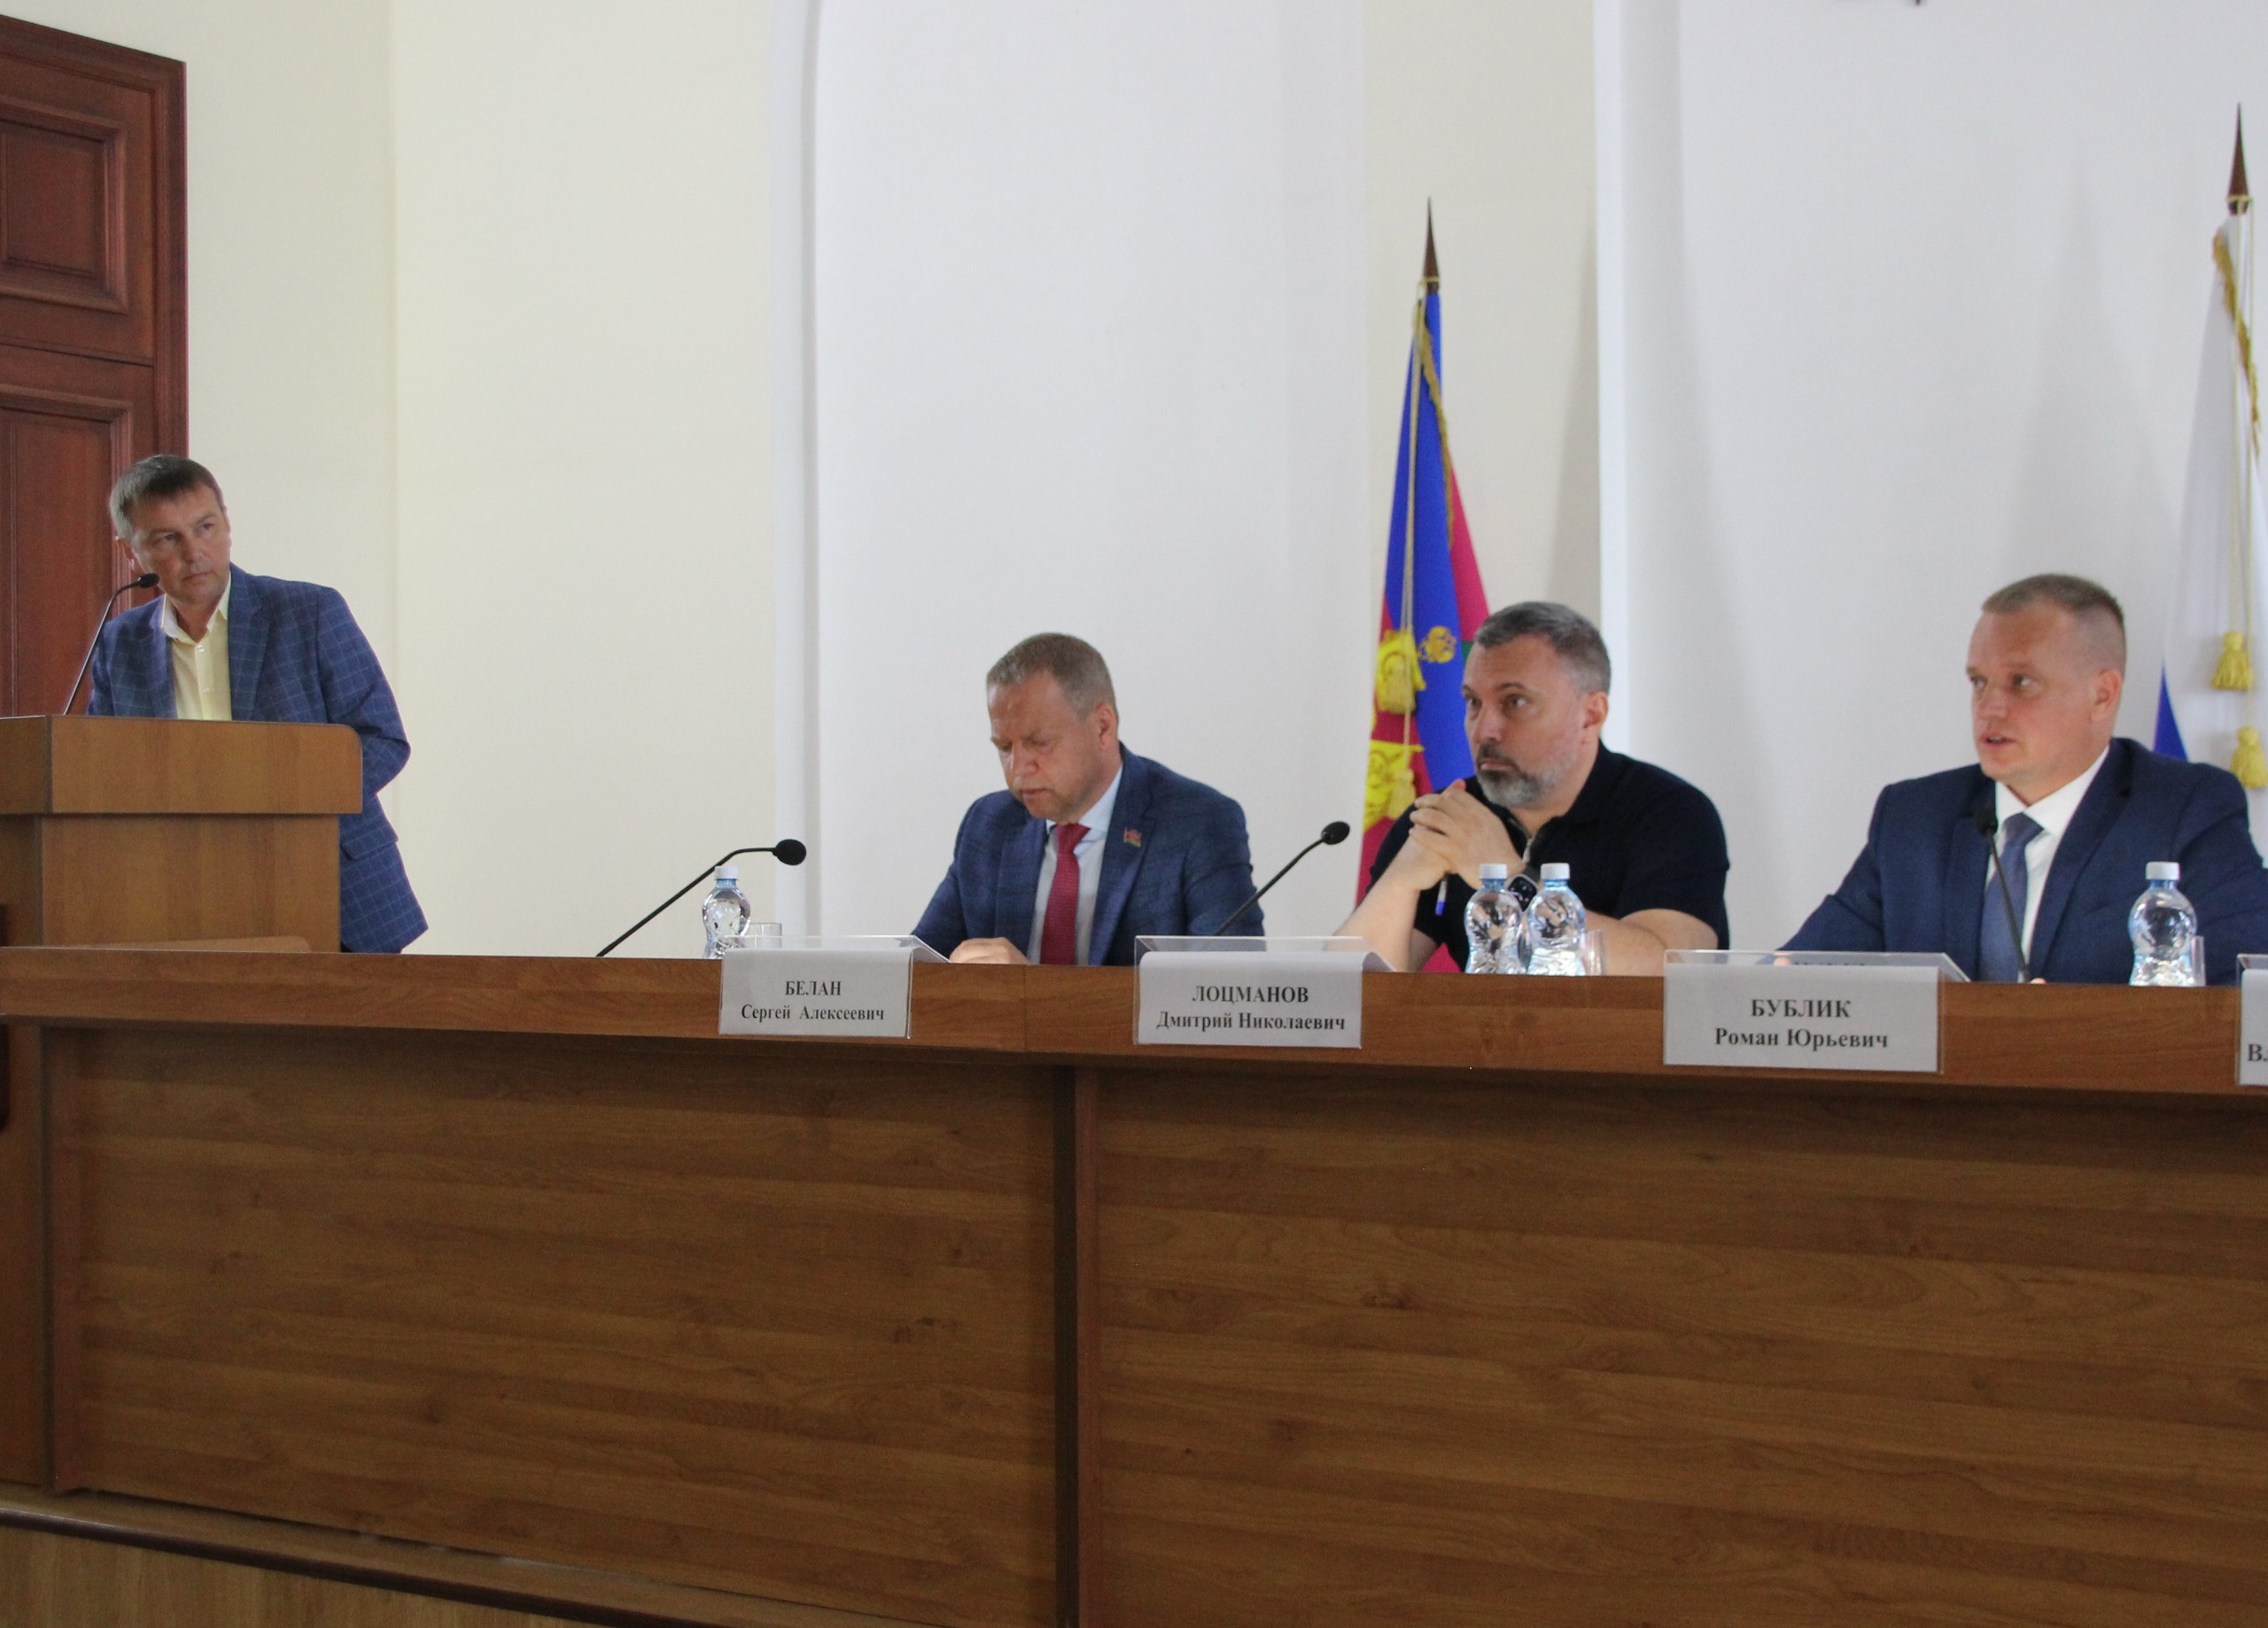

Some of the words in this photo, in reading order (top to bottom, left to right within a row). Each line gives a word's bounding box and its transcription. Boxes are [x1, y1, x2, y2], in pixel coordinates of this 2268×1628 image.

[785, 981, 842, 996] БЕЛАН
[1192, 985, 1309, 1004] ЛОЦМАНОВ
[741, 1004, 790, 1023] Сергей
[799, 1005, 884, 1020] Алексеевич
[1751, 998, 1852, 1019] БУБЛИК
[1156, 1011, 1232, 1032] Дмитрий
[1239, 1012, 1345, 1030] Николаевич
[1715, 1027, 1779, 1046] Роман
[1787, 1028, 1888, 1051] Юрьевич
